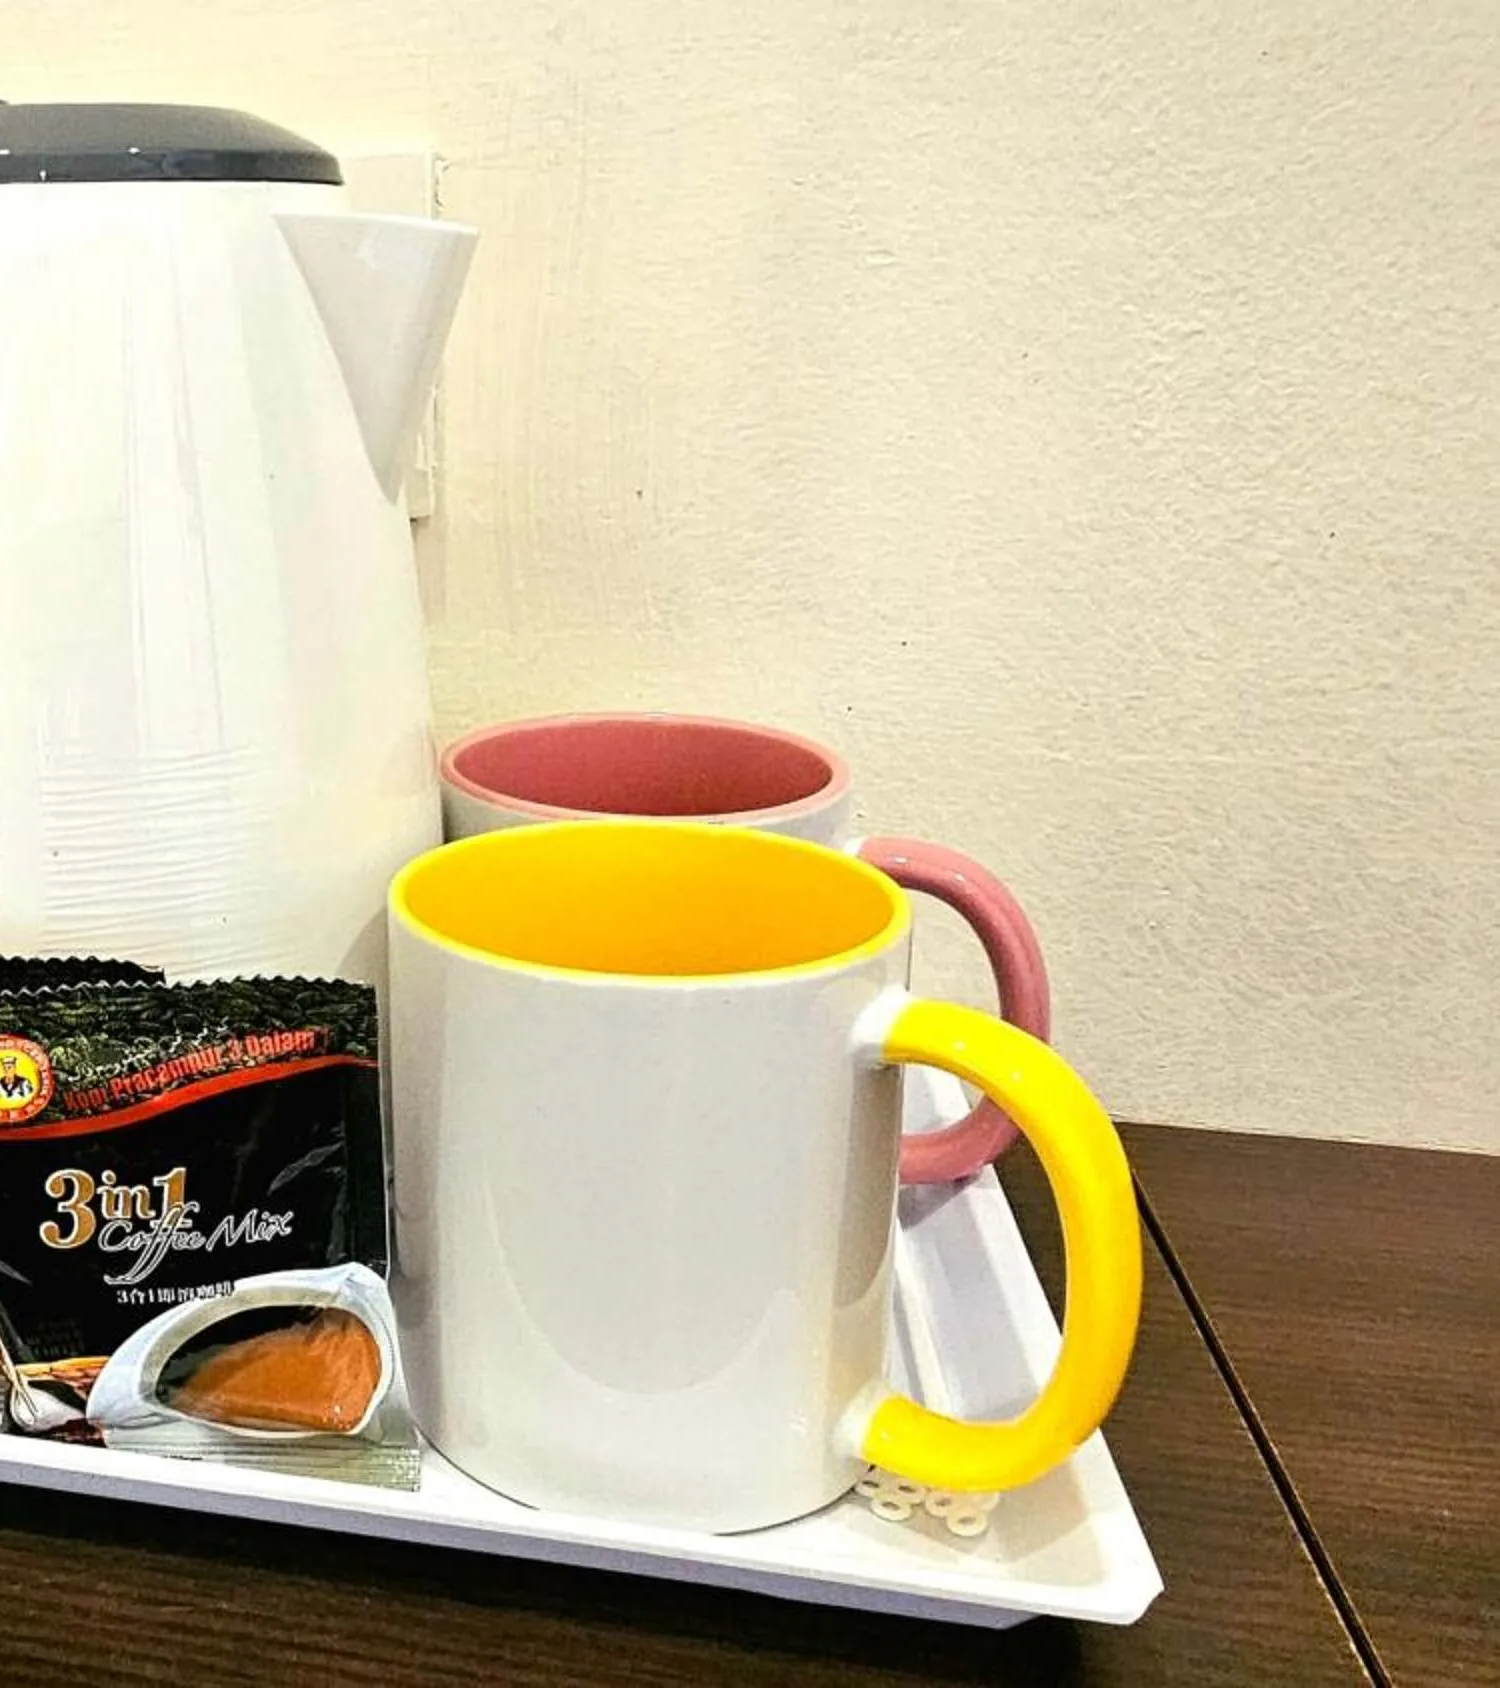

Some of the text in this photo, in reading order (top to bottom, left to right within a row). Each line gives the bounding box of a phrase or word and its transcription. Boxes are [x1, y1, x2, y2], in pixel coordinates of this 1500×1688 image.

[246, 1030, 316, 1057] Dalam
[98, 1201, 295, 1285] Coffee Mix
